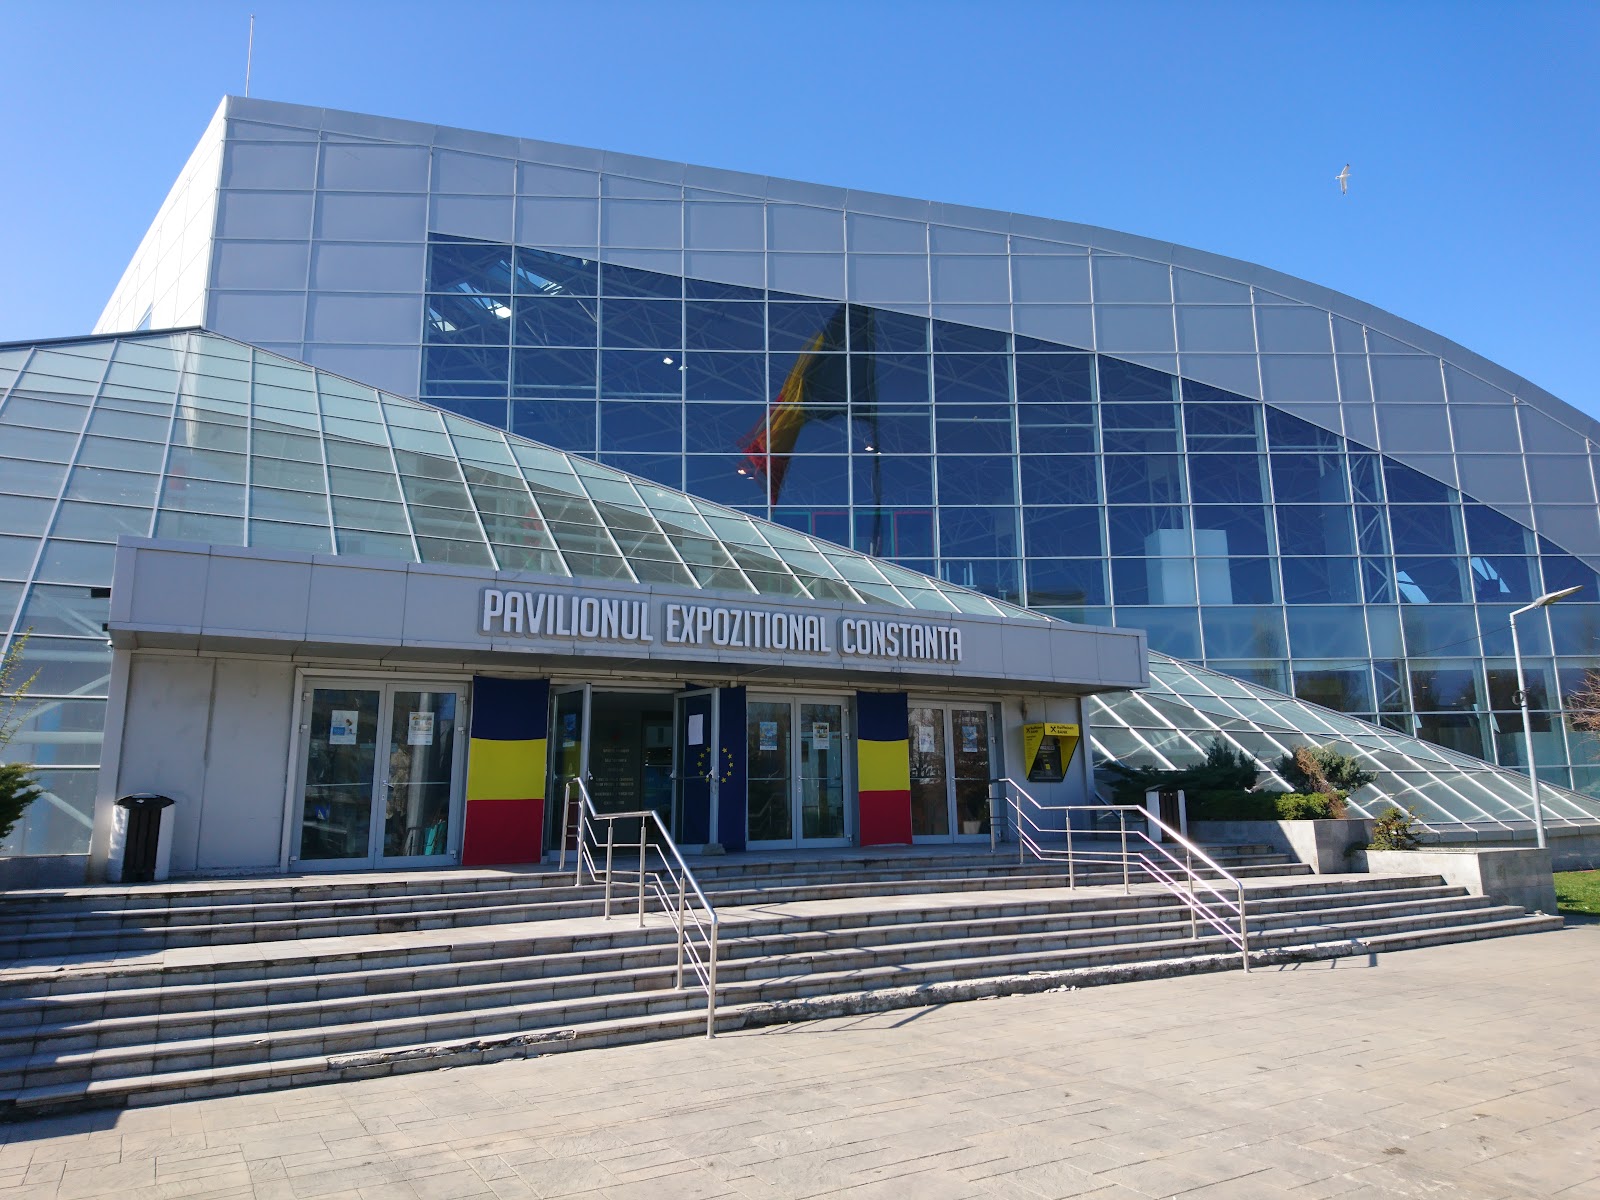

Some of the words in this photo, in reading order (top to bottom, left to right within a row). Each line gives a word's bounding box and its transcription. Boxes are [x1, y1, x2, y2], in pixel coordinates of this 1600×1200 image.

[482, 589, 654, 641] PAVILIONUL
[666, 604, 831, 652] EXPOZITIONAL
[842, 618, 962, 662] CONSTANTA
